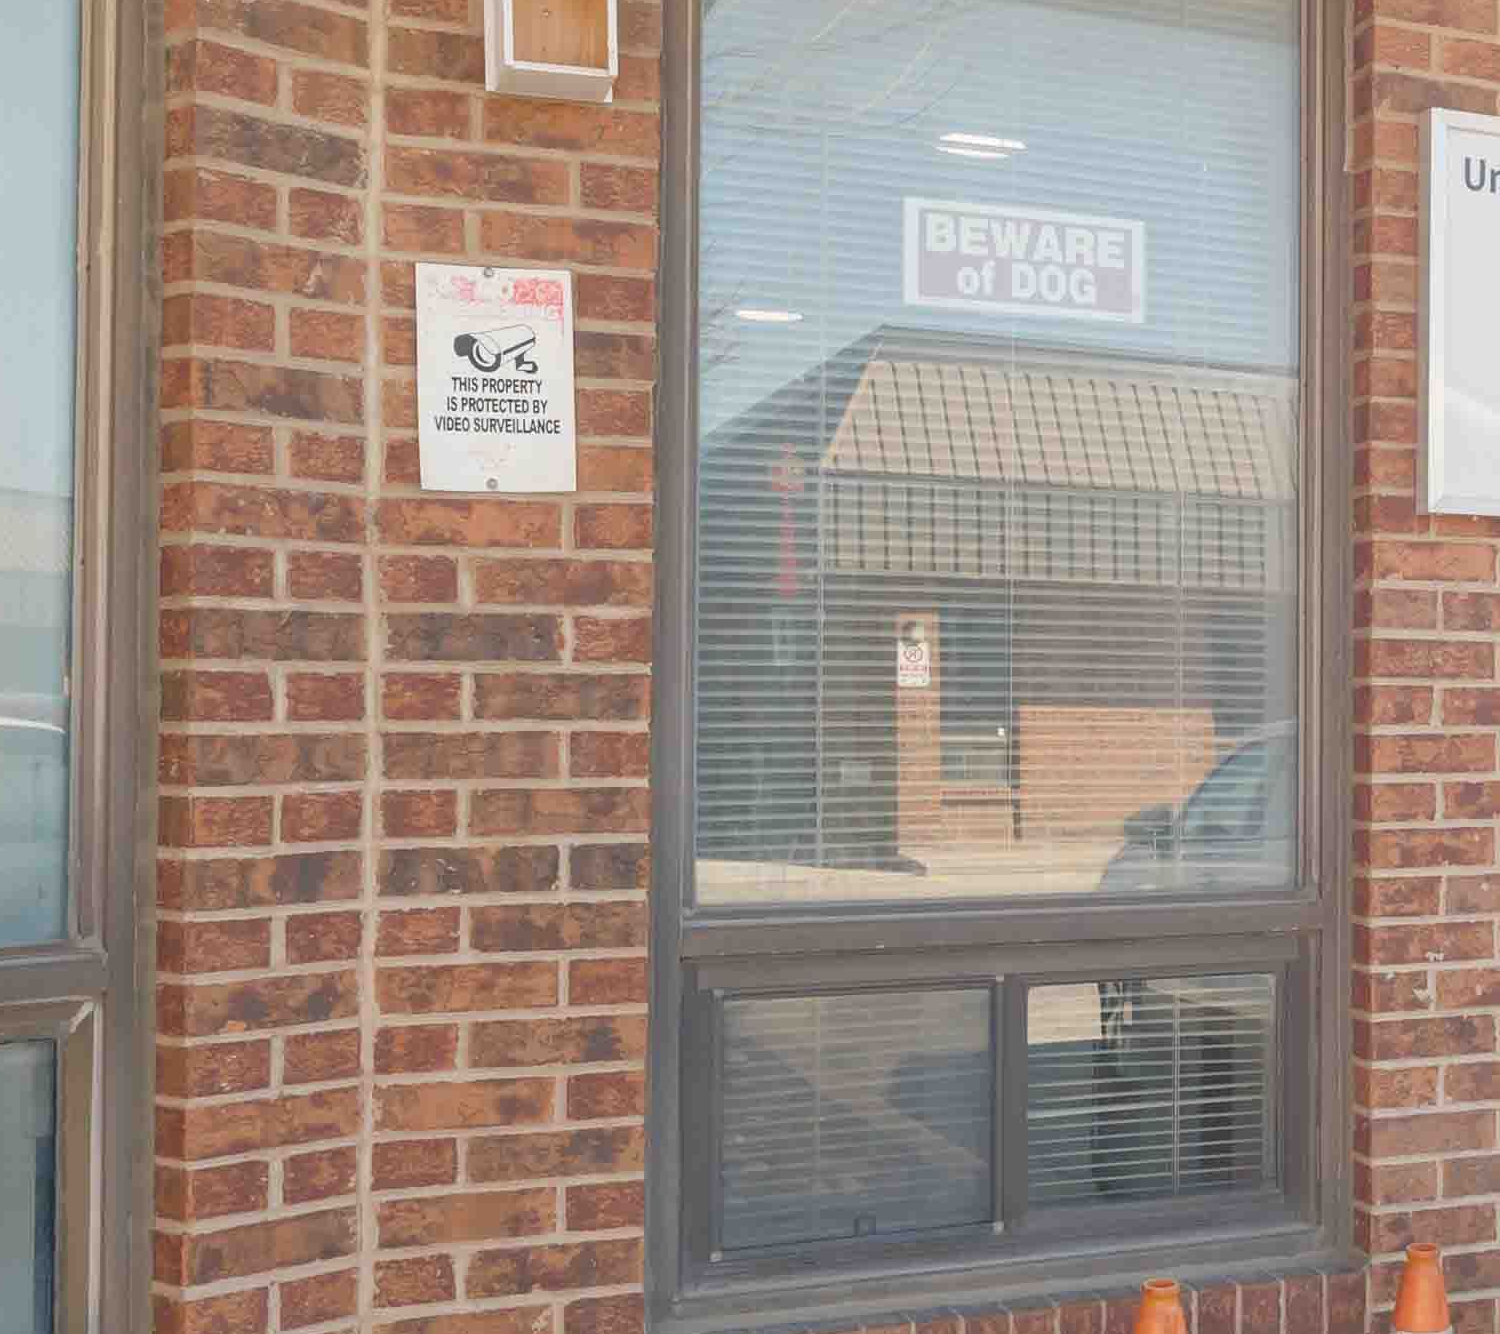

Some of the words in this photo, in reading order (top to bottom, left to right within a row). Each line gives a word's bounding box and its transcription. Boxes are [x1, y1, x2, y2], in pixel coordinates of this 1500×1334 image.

[925, 212, 1125, 268] BEWARE
[957, 260, 997, 296] of
[1011, 261, 1098, 305] DOG
[451, 376, 478, 393] THIS
[482, 377, 542, 395] PROPERTY
[446, 396, 458, 412] IS
[461, 397, 529, 414] PROTECTED
[533, 399, 548, 414] BY
[434, 415, 471, 432] VIDEO
[473, 417, 562, 435] SURVEILLANCE
